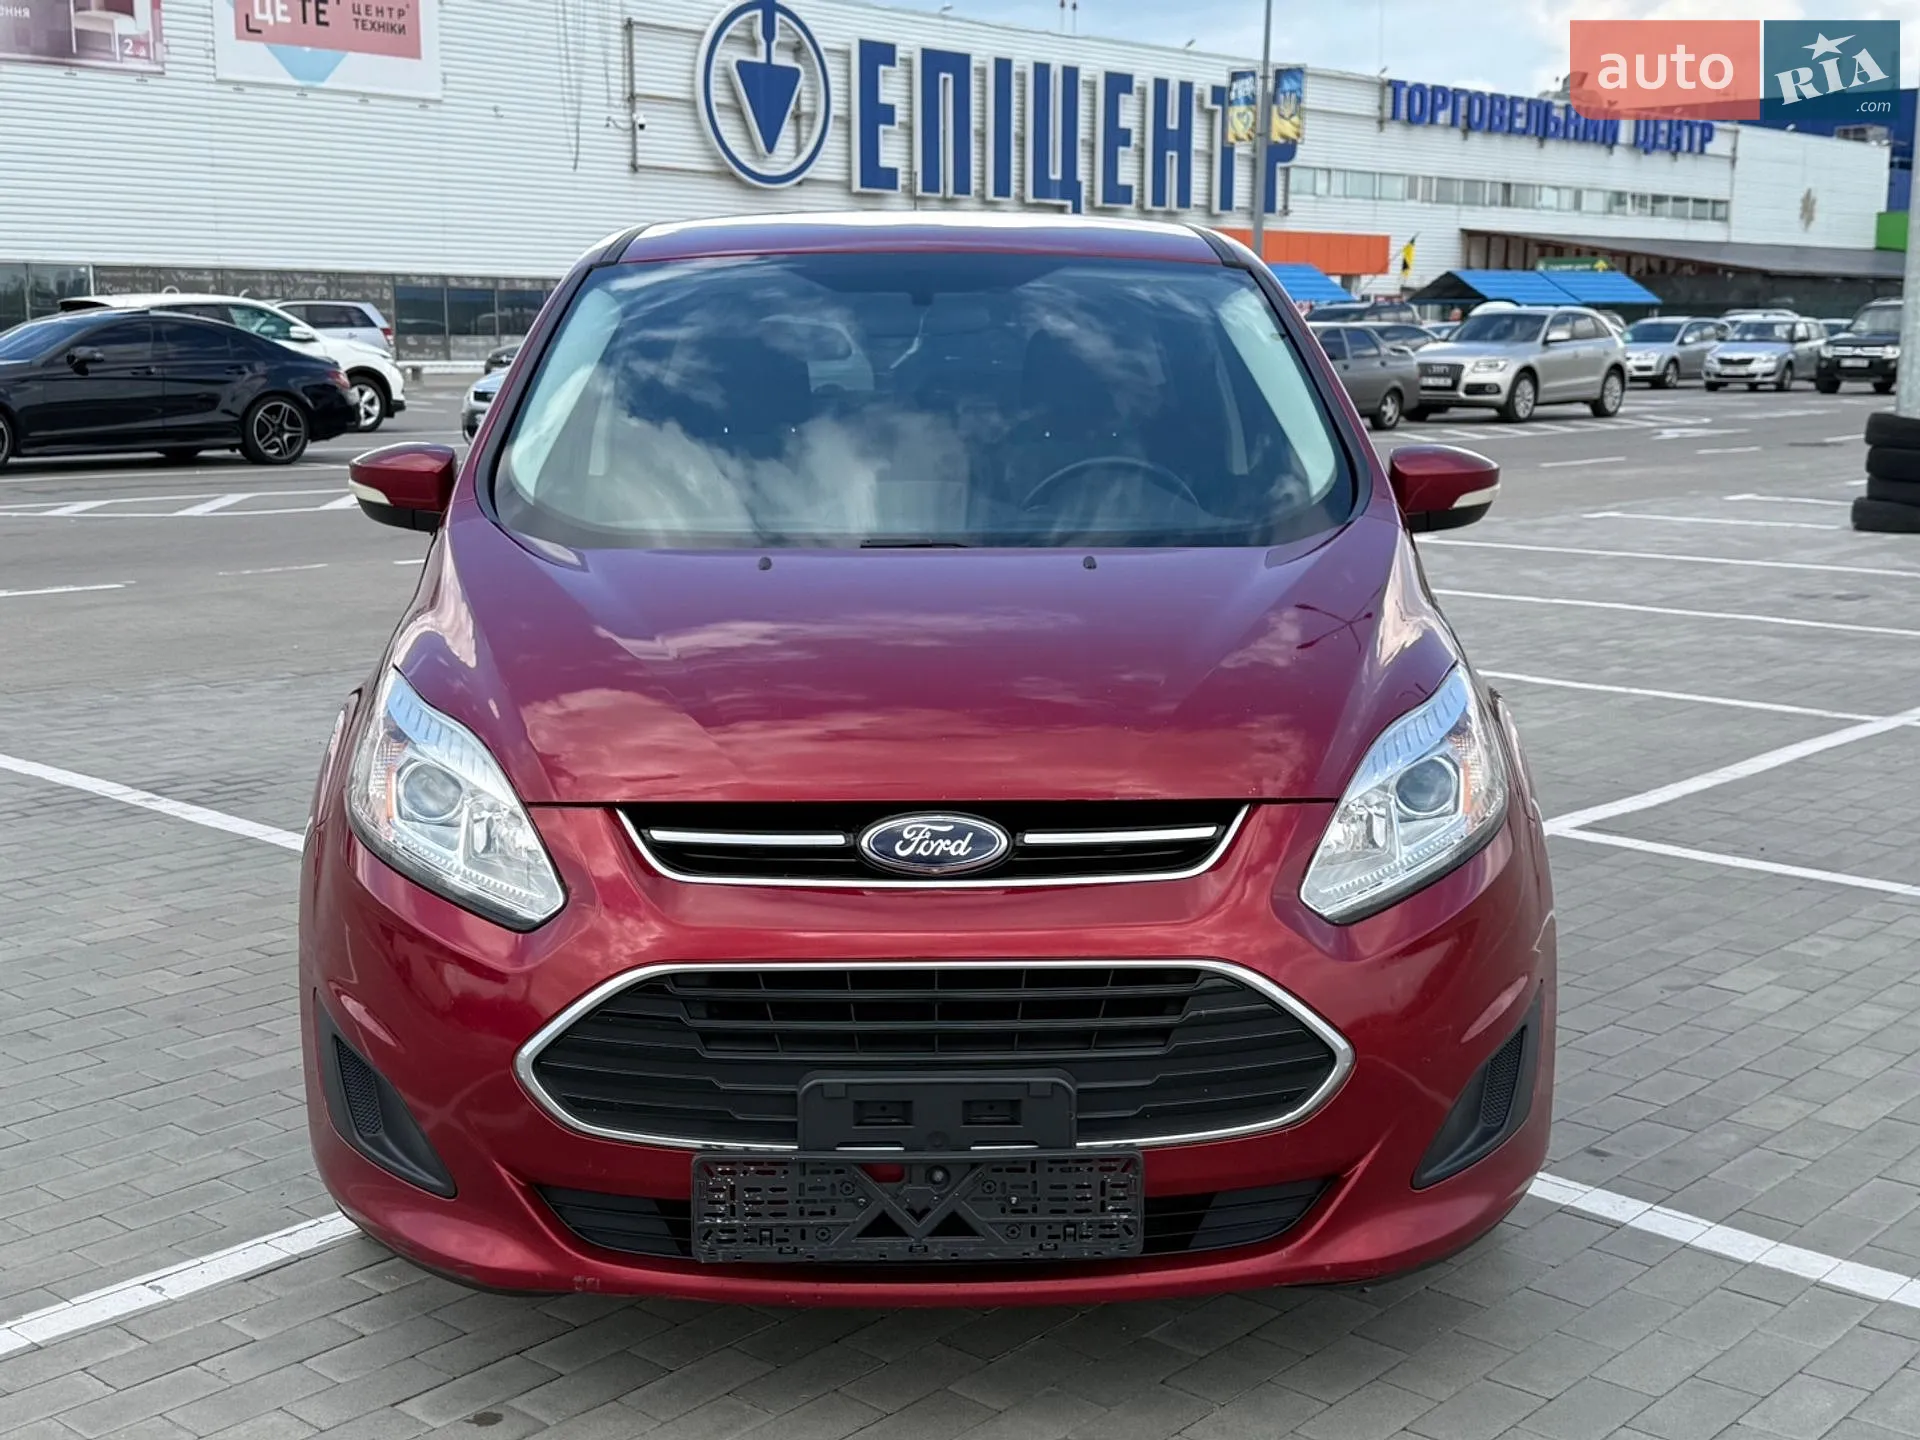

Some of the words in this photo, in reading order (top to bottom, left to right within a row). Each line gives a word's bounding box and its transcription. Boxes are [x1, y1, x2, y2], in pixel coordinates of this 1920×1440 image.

[352, 18, 407, 35] ТЕХНІКИ
[1388, 79, 1620, 147] ТОРГОВЕЛЬНИЙ
[1634, 110, 1715, 155] ЦЕНТР
[894, 823, 974, 857] Ford
